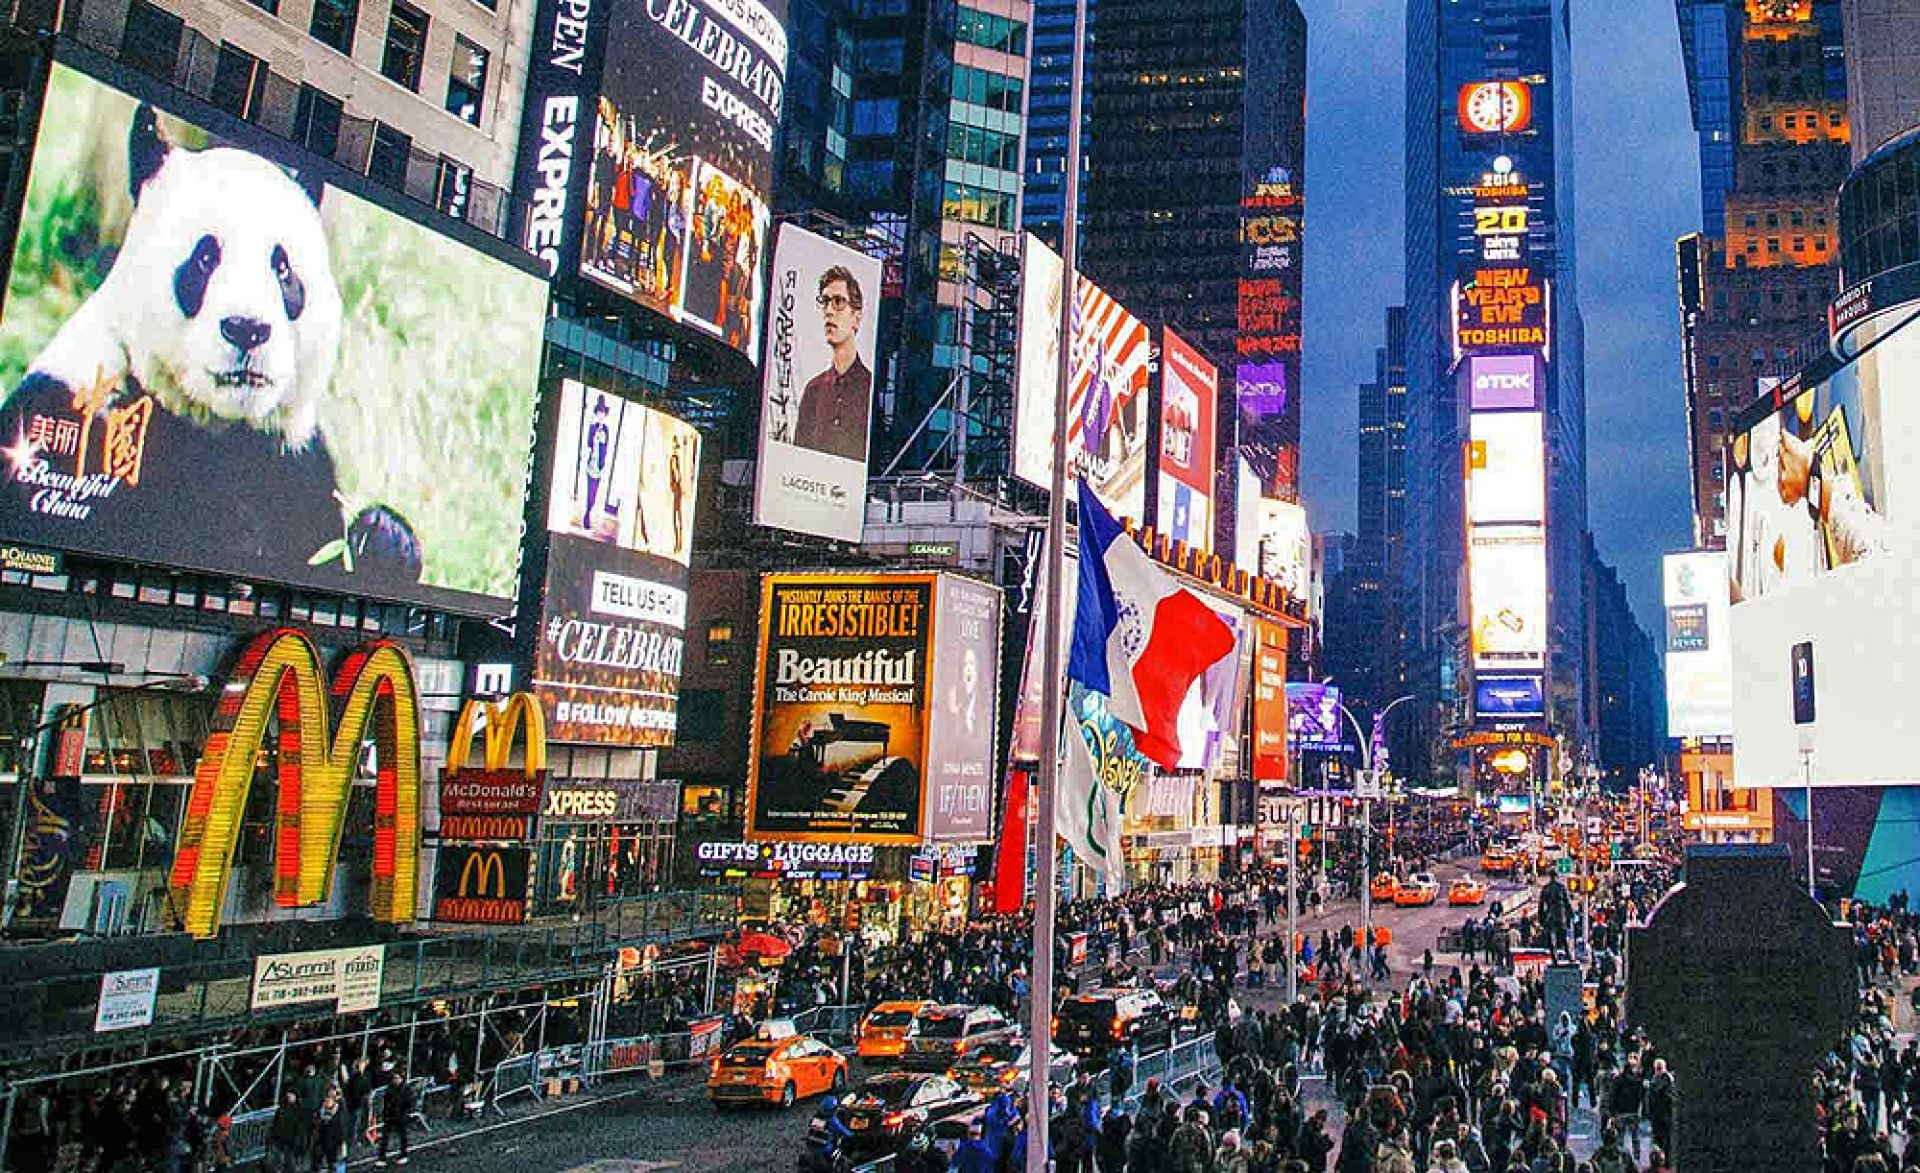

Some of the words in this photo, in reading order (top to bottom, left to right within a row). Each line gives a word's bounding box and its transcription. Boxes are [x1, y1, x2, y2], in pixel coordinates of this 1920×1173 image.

[1475, 186, 1528, 197] TOSHIBA
[1475, 207, 1527, 234] 20
[1476, 269, 1529, 286] NEW
[1481, 305, 1524, 323] EVE
[1459, 328, 1544, 344] TOSHIBA
[1488, 373, 1532, 389] TDK
[782, 475, 827, 496] LACOSTE
[602, 581, 634, 607] TELL
[777, 648, 916, 684] Beautiful
[775, 687, 797, 702] The
[798, 687, 836, 702] Carole
[838, 687, 867, 707] King
[868, 687, 914, 704] Musical
[571, 704, 630, 729] FOLLOW
[443, 783, 537, 798] McDonald's
[698, 842, 759, 862] GIFTS
[774, 843, 874, 864] LUGGAGE
